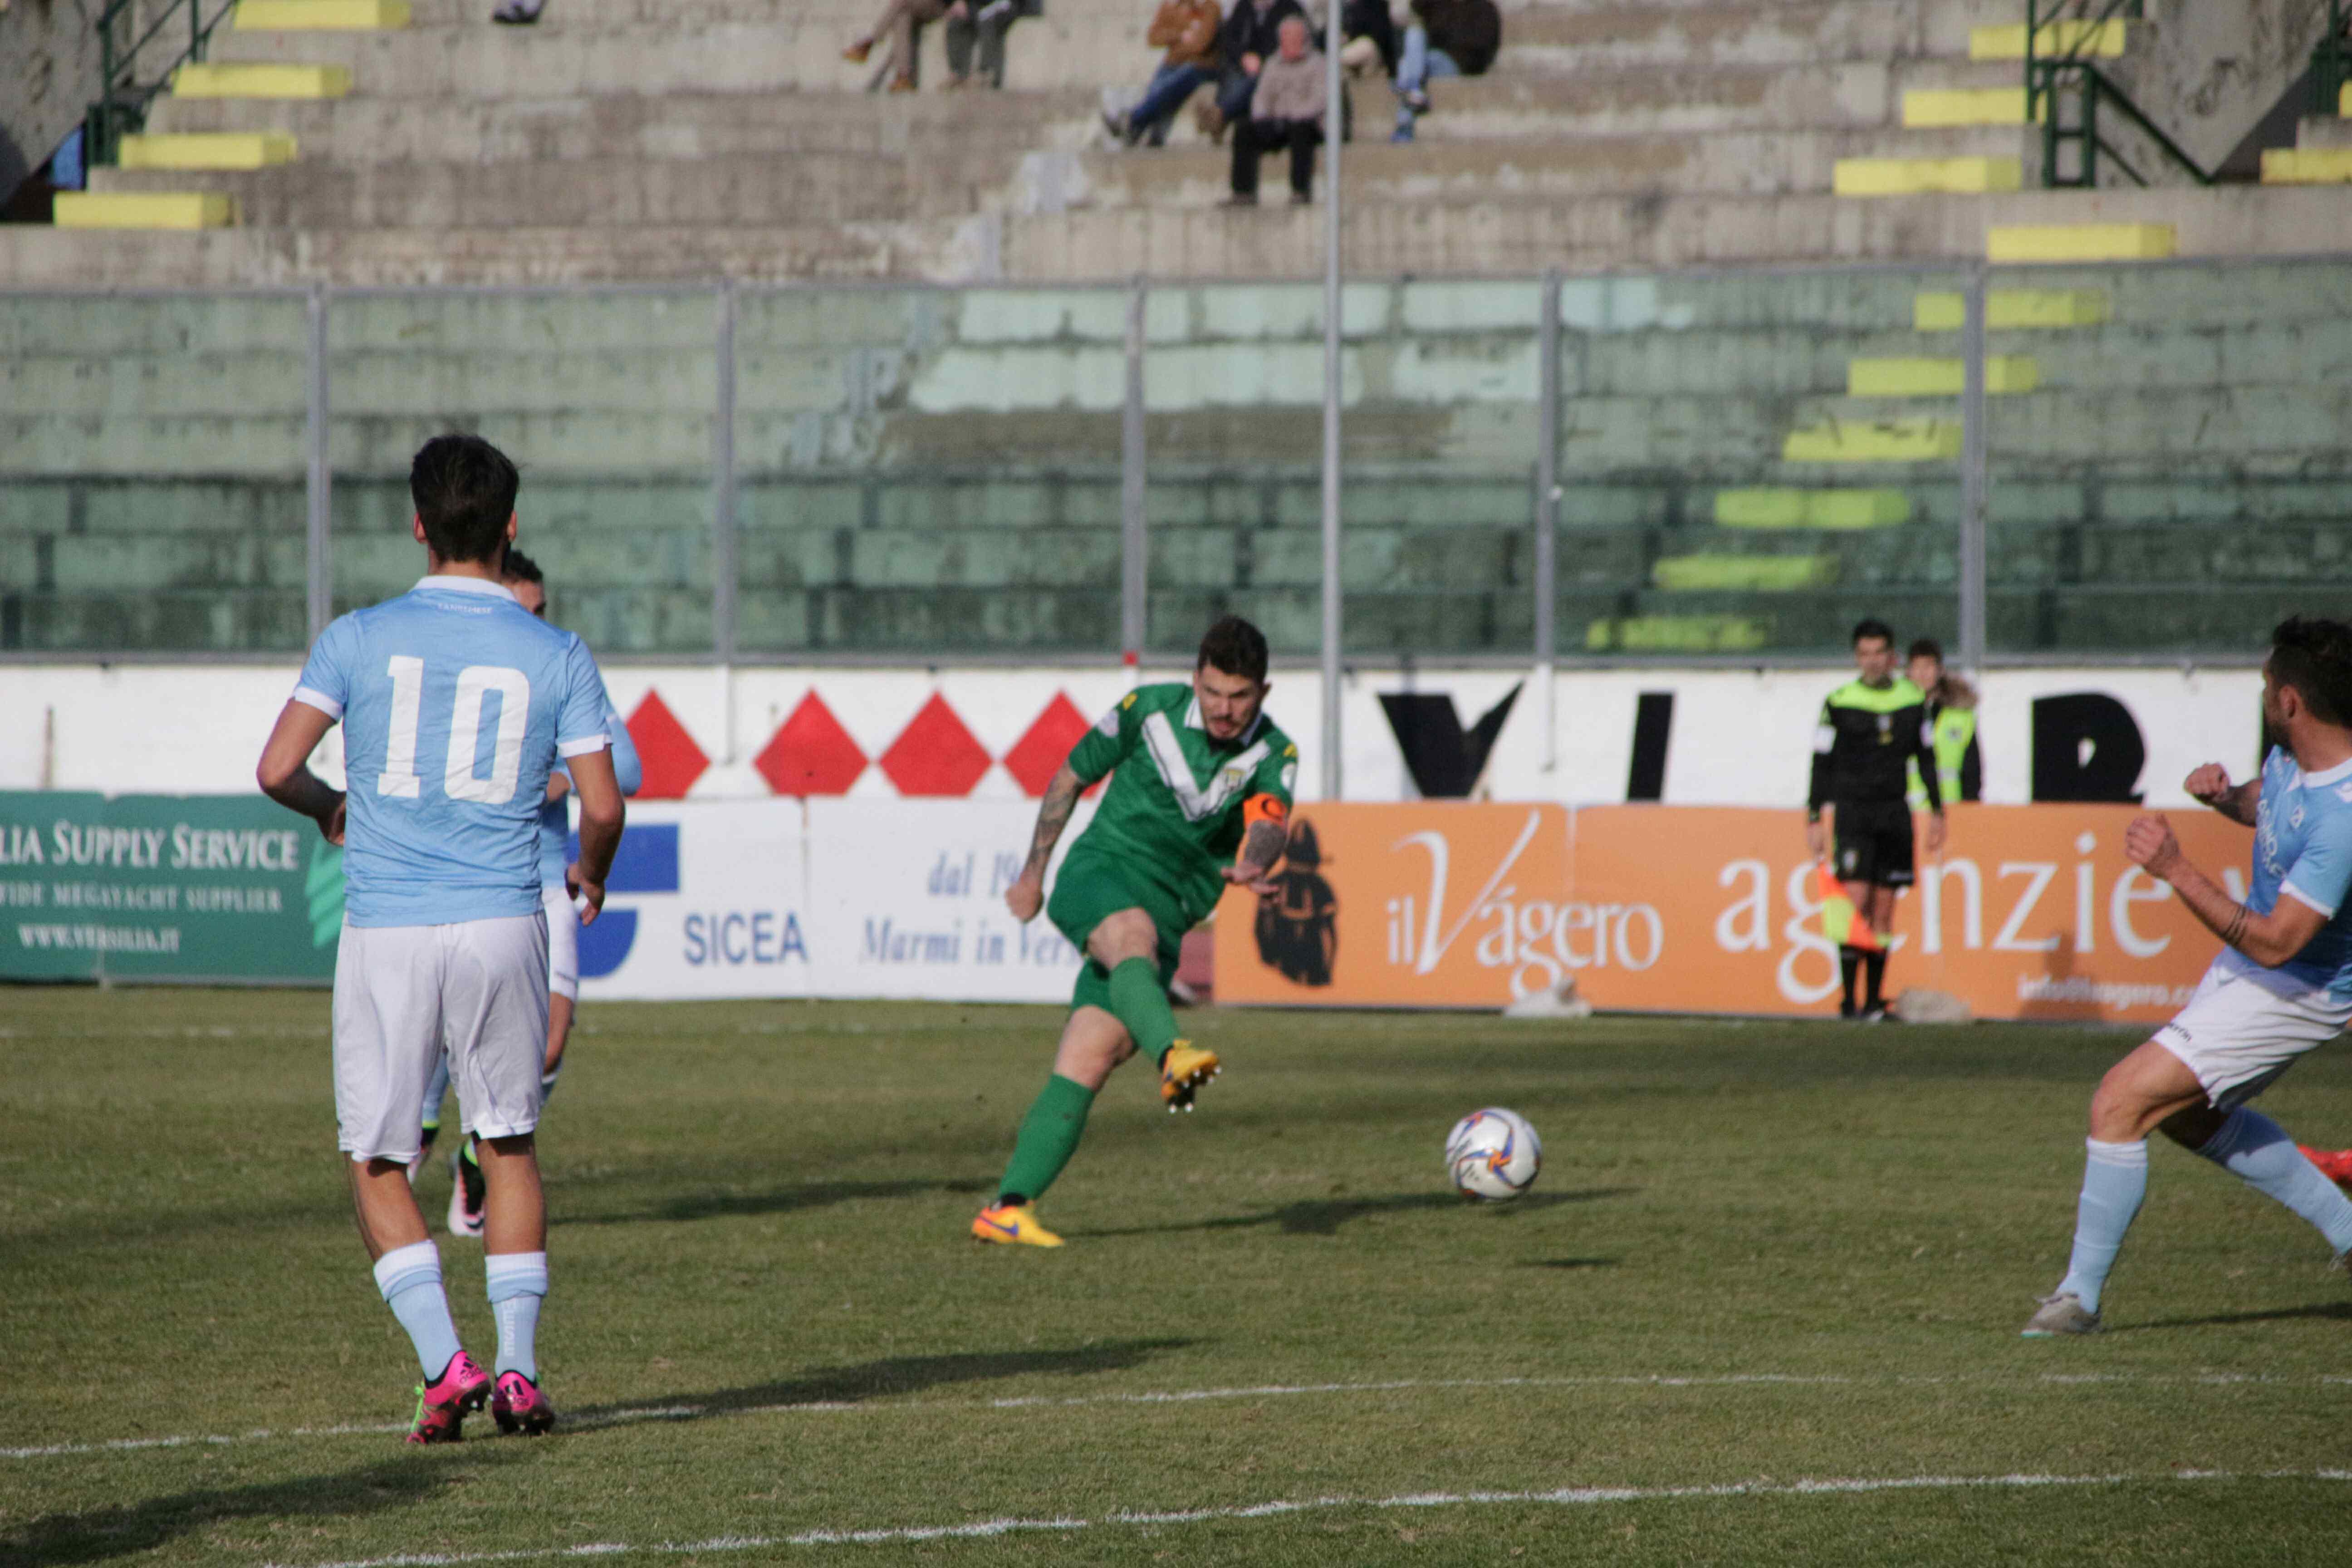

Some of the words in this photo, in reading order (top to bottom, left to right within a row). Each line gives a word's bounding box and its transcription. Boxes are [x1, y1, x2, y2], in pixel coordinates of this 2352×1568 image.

[377, 655, 530, 804] 10
[928, 852, 974, 896] dal
[684, 911, 808, 965] SICEA
[975, 918, 1004, 965] in
[1715, 834, 2173, 1004] agnzie
